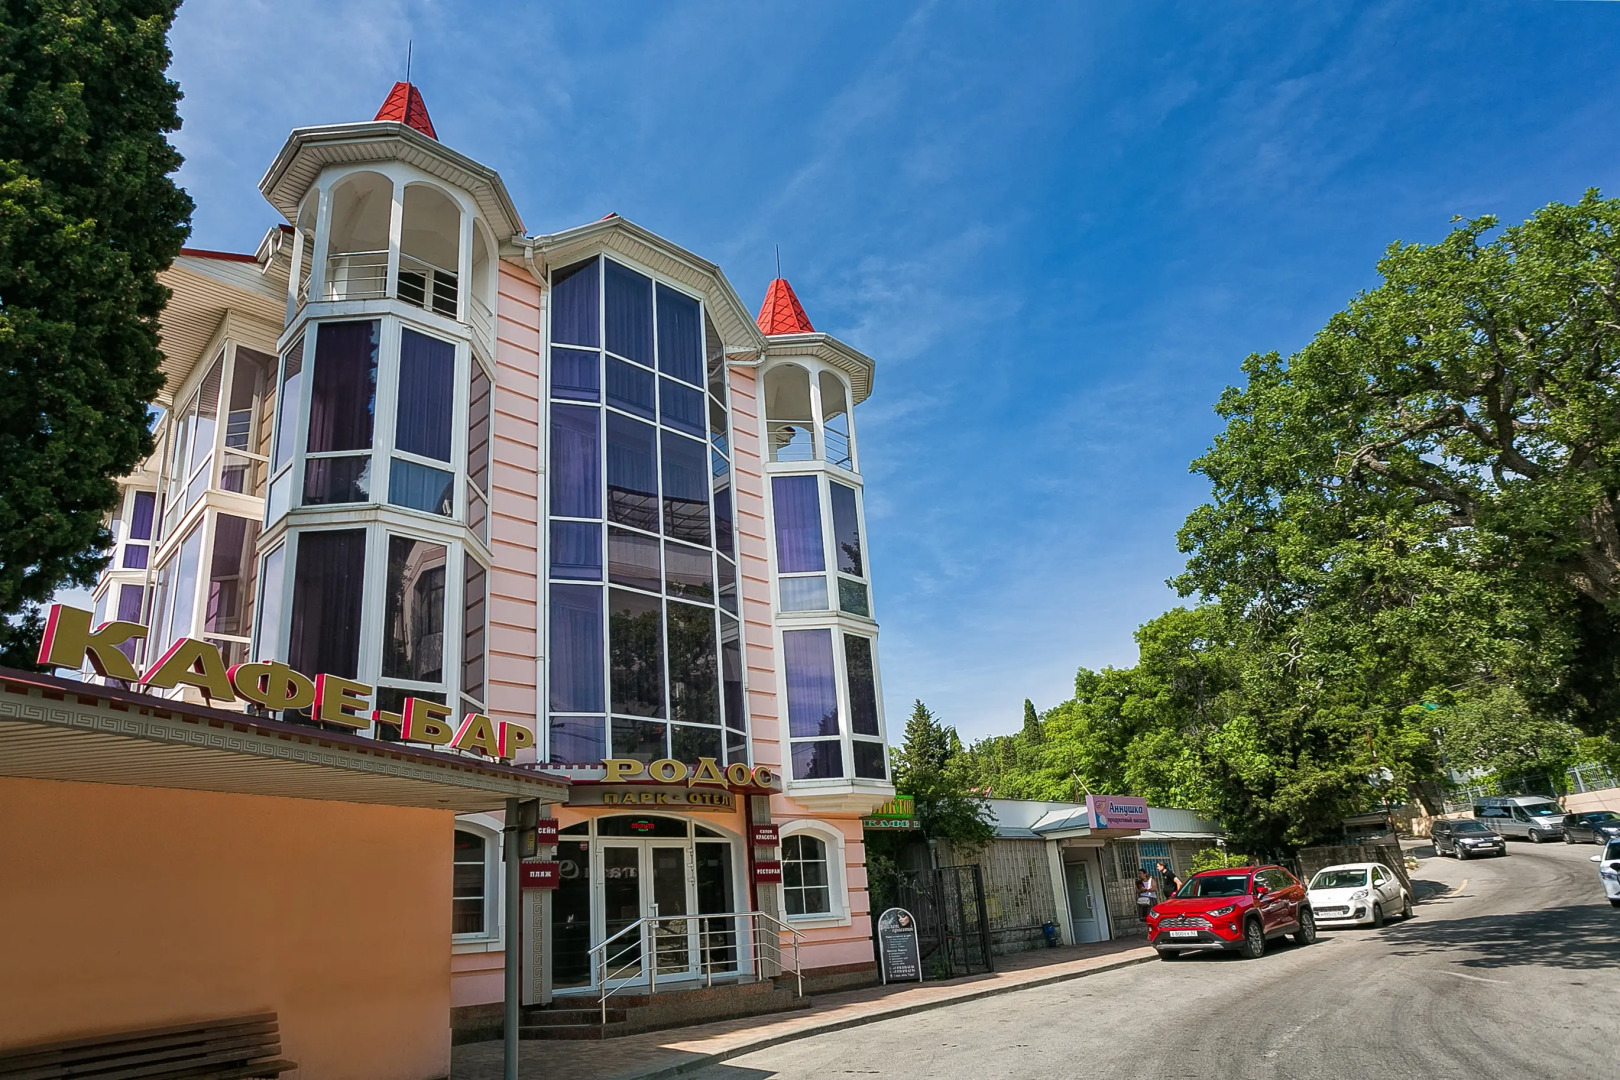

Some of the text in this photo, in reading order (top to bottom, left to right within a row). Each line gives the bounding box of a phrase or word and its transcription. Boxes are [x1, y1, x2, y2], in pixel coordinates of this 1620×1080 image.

[37, 604, 534, 760] КАФЕ-БАР
[600, 756, 773, 790] РОДОС
[1109, 801, 1144, 817] Аннушка
[538, 826, 556, 834] СЕЙН
